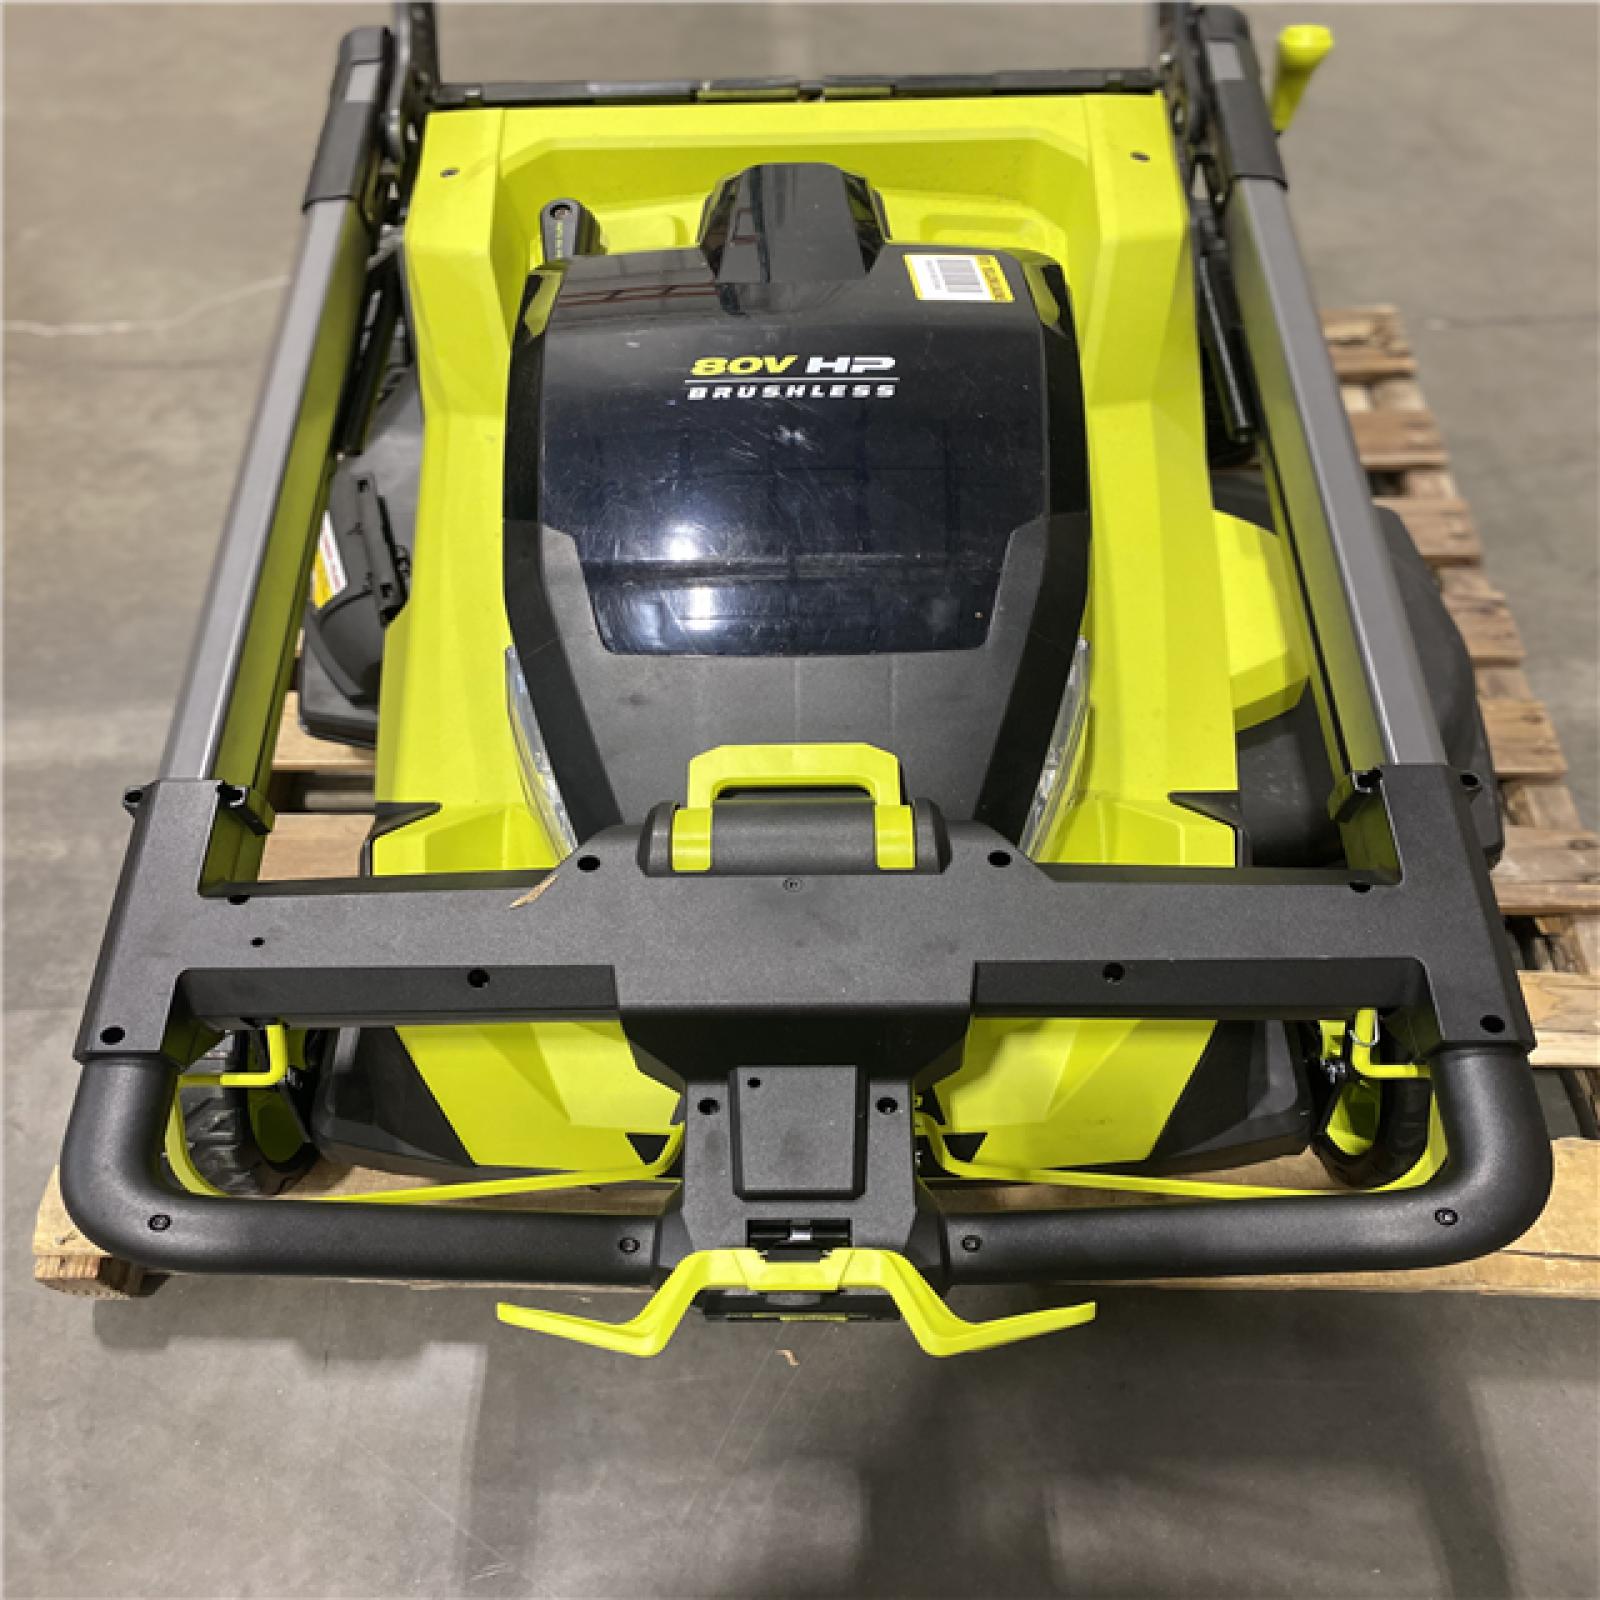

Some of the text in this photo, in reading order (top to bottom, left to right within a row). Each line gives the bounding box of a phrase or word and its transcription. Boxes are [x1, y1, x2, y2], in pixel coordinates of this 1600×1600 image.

[691, 354, 896, 376] 80V HP
[687, 384, 896, 401] BRUSHLESS
